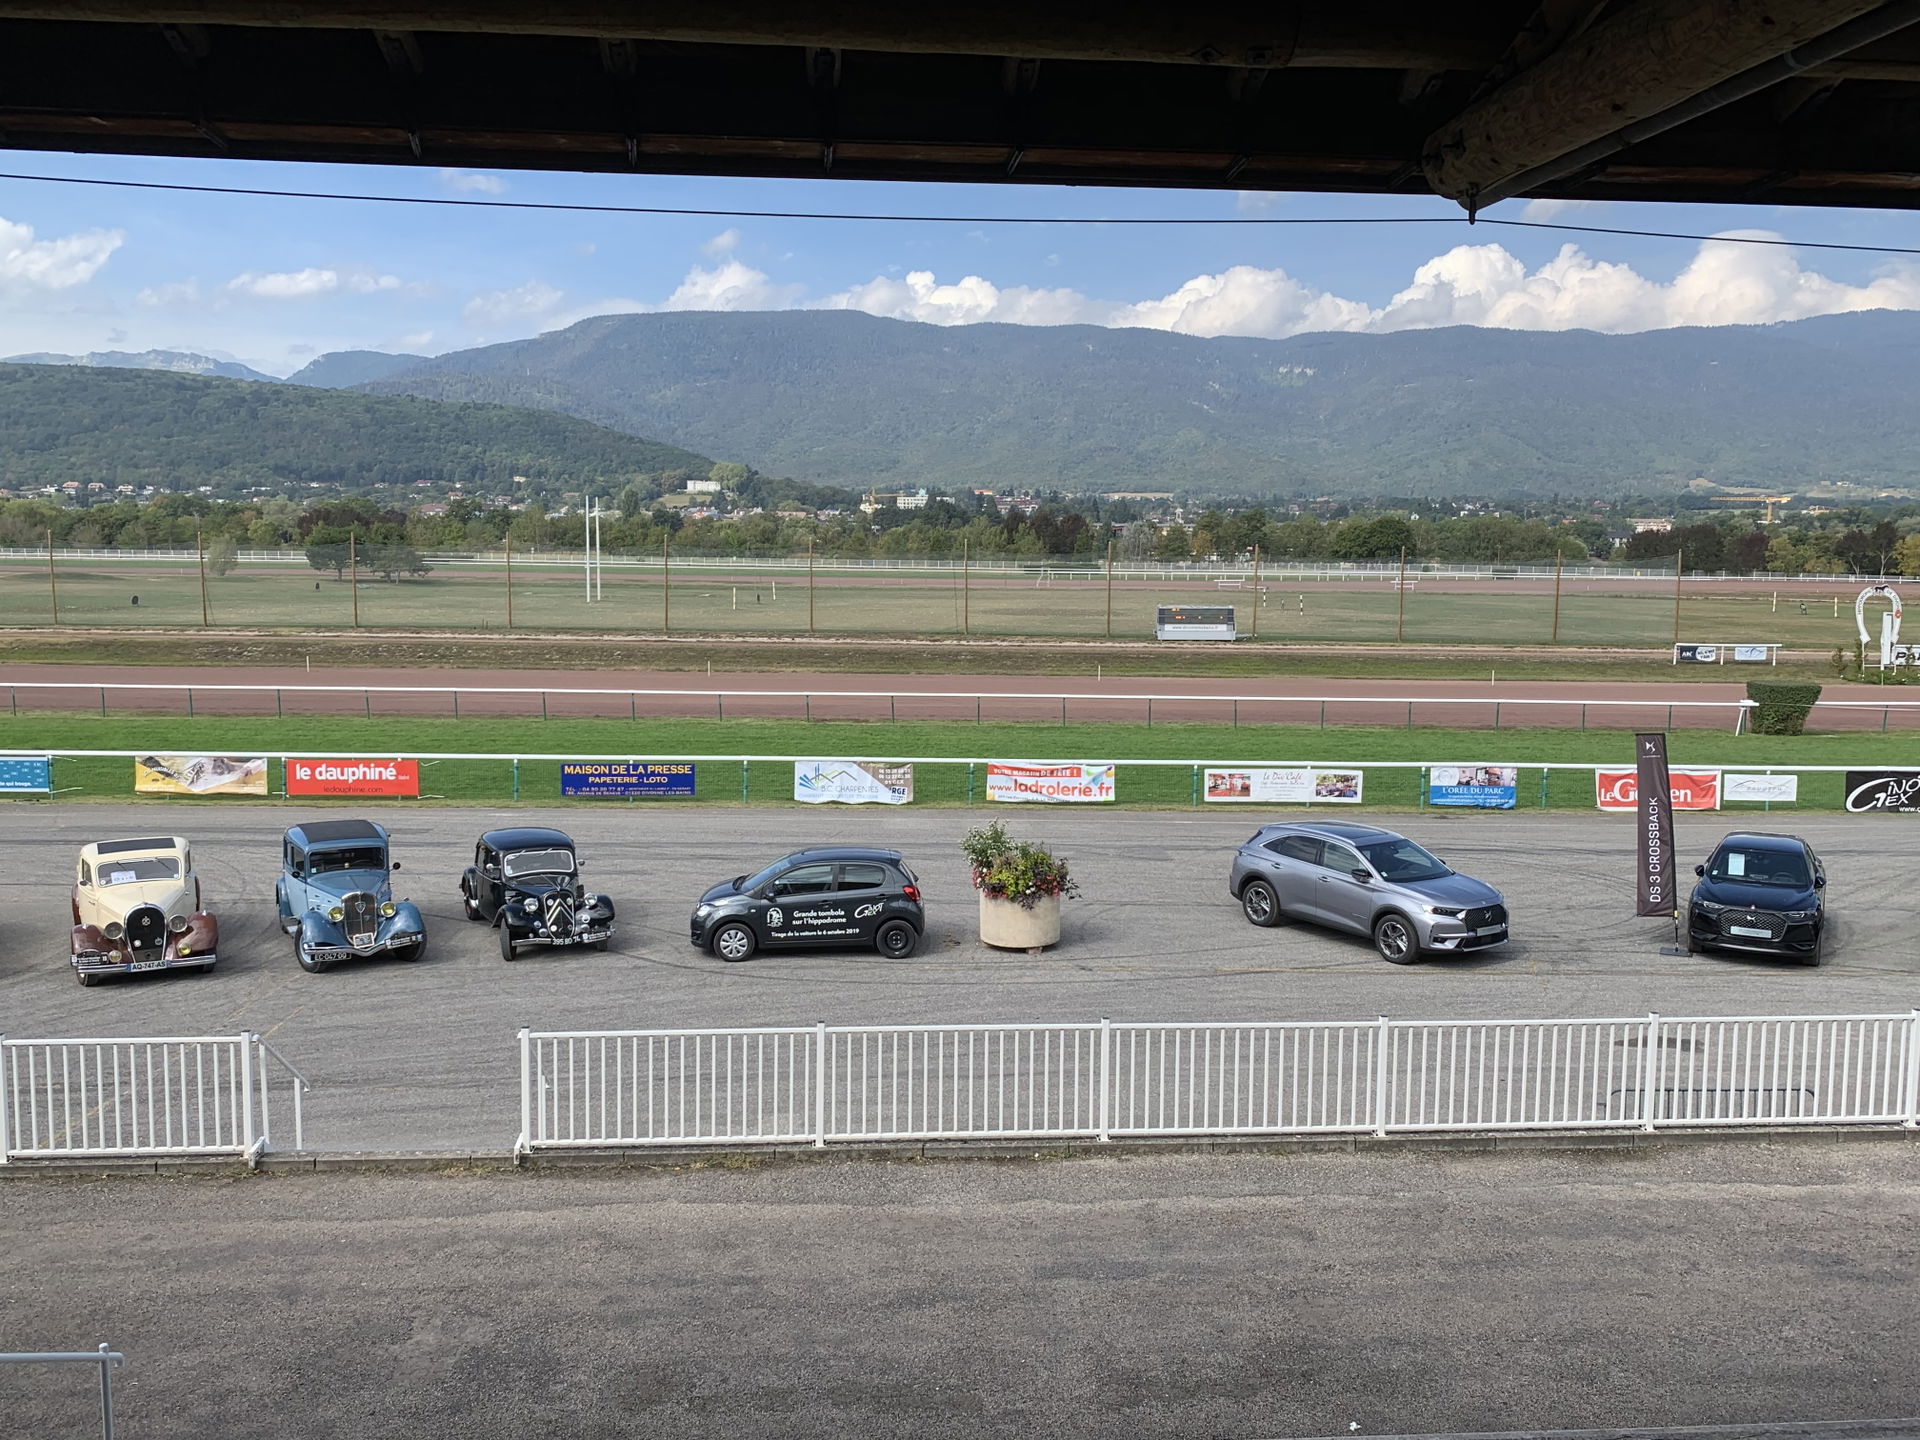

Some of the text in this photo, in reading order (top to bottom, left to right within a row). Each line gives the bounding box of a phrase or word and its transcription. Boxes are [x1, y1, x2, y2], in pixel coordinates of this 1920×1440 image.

[295, 762, 397, 783] le dauphiné
[564, 765, 692, 774] MAISON DE LA PRESSE
[891, 787, 907, 795] RGE
[989, 778, 1112, 797] www.ladrolerie.fr
[1470, 786, 1483, 794] DU
[1484, 786, 1504, 794] PARC
[1649, 797, 1661, 903] DS 3 CROSSBACK
[818, 908, 844, 916] tombola
[804, 917, 847, 926] l'hippodrome
[132, 961, 165, 970] AQ-747-AS
